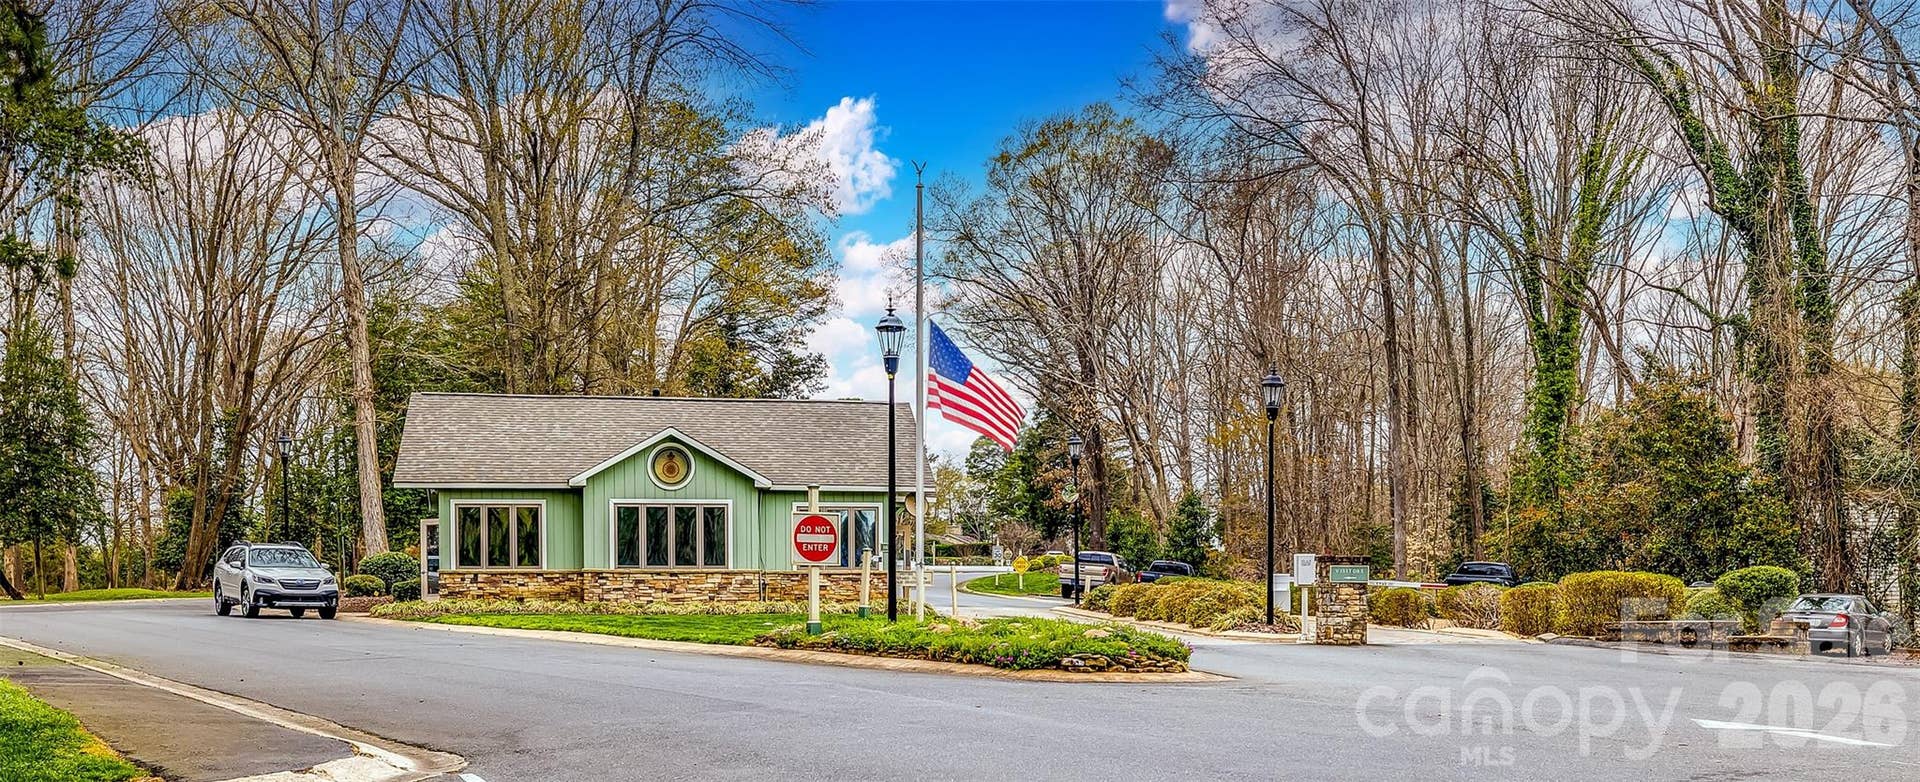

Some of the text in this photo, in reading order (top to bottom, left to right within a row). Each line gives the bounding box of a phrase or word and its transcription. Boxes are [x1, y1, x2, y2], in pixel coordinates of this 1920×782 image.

[800, 525, 831, 534] DO NOT
[802, 543, 829, 552] ENTER
